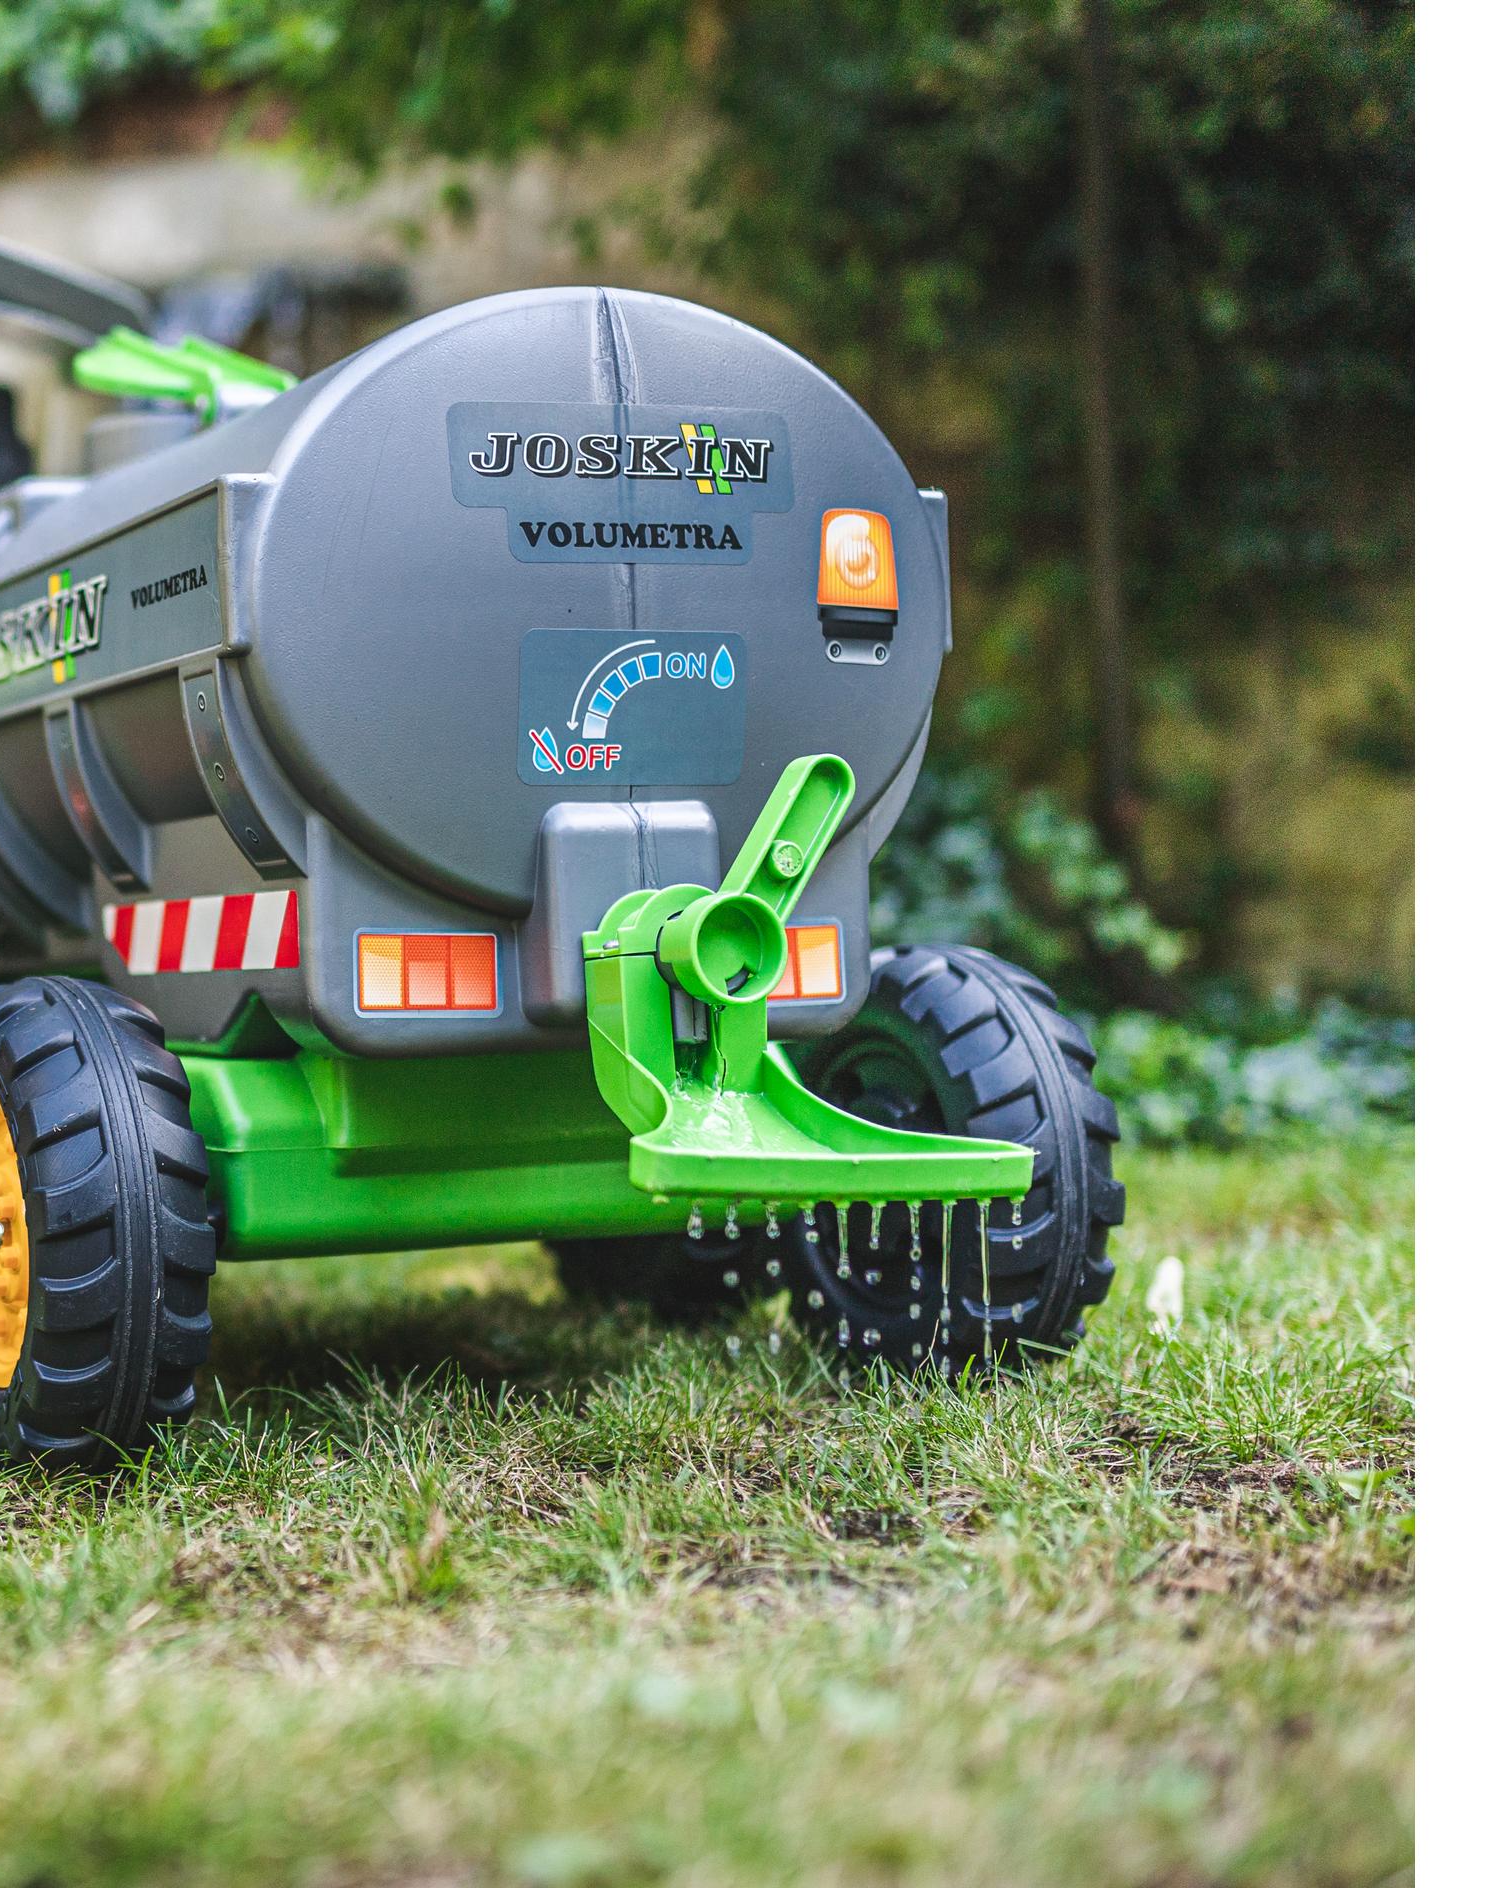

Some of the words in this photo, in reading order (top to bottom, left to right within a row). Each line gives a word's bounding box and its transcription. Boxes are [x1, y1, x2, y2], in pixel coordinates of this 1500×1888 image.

[468, 430, 775, 483] JOSKIN
[518, 520, 743, 550] VOLUMETRA
[130, 564, 208, 610] VOLUMETRA
[665, 652, 707, 679] ON
[565, 744, 622, 771] OFF
